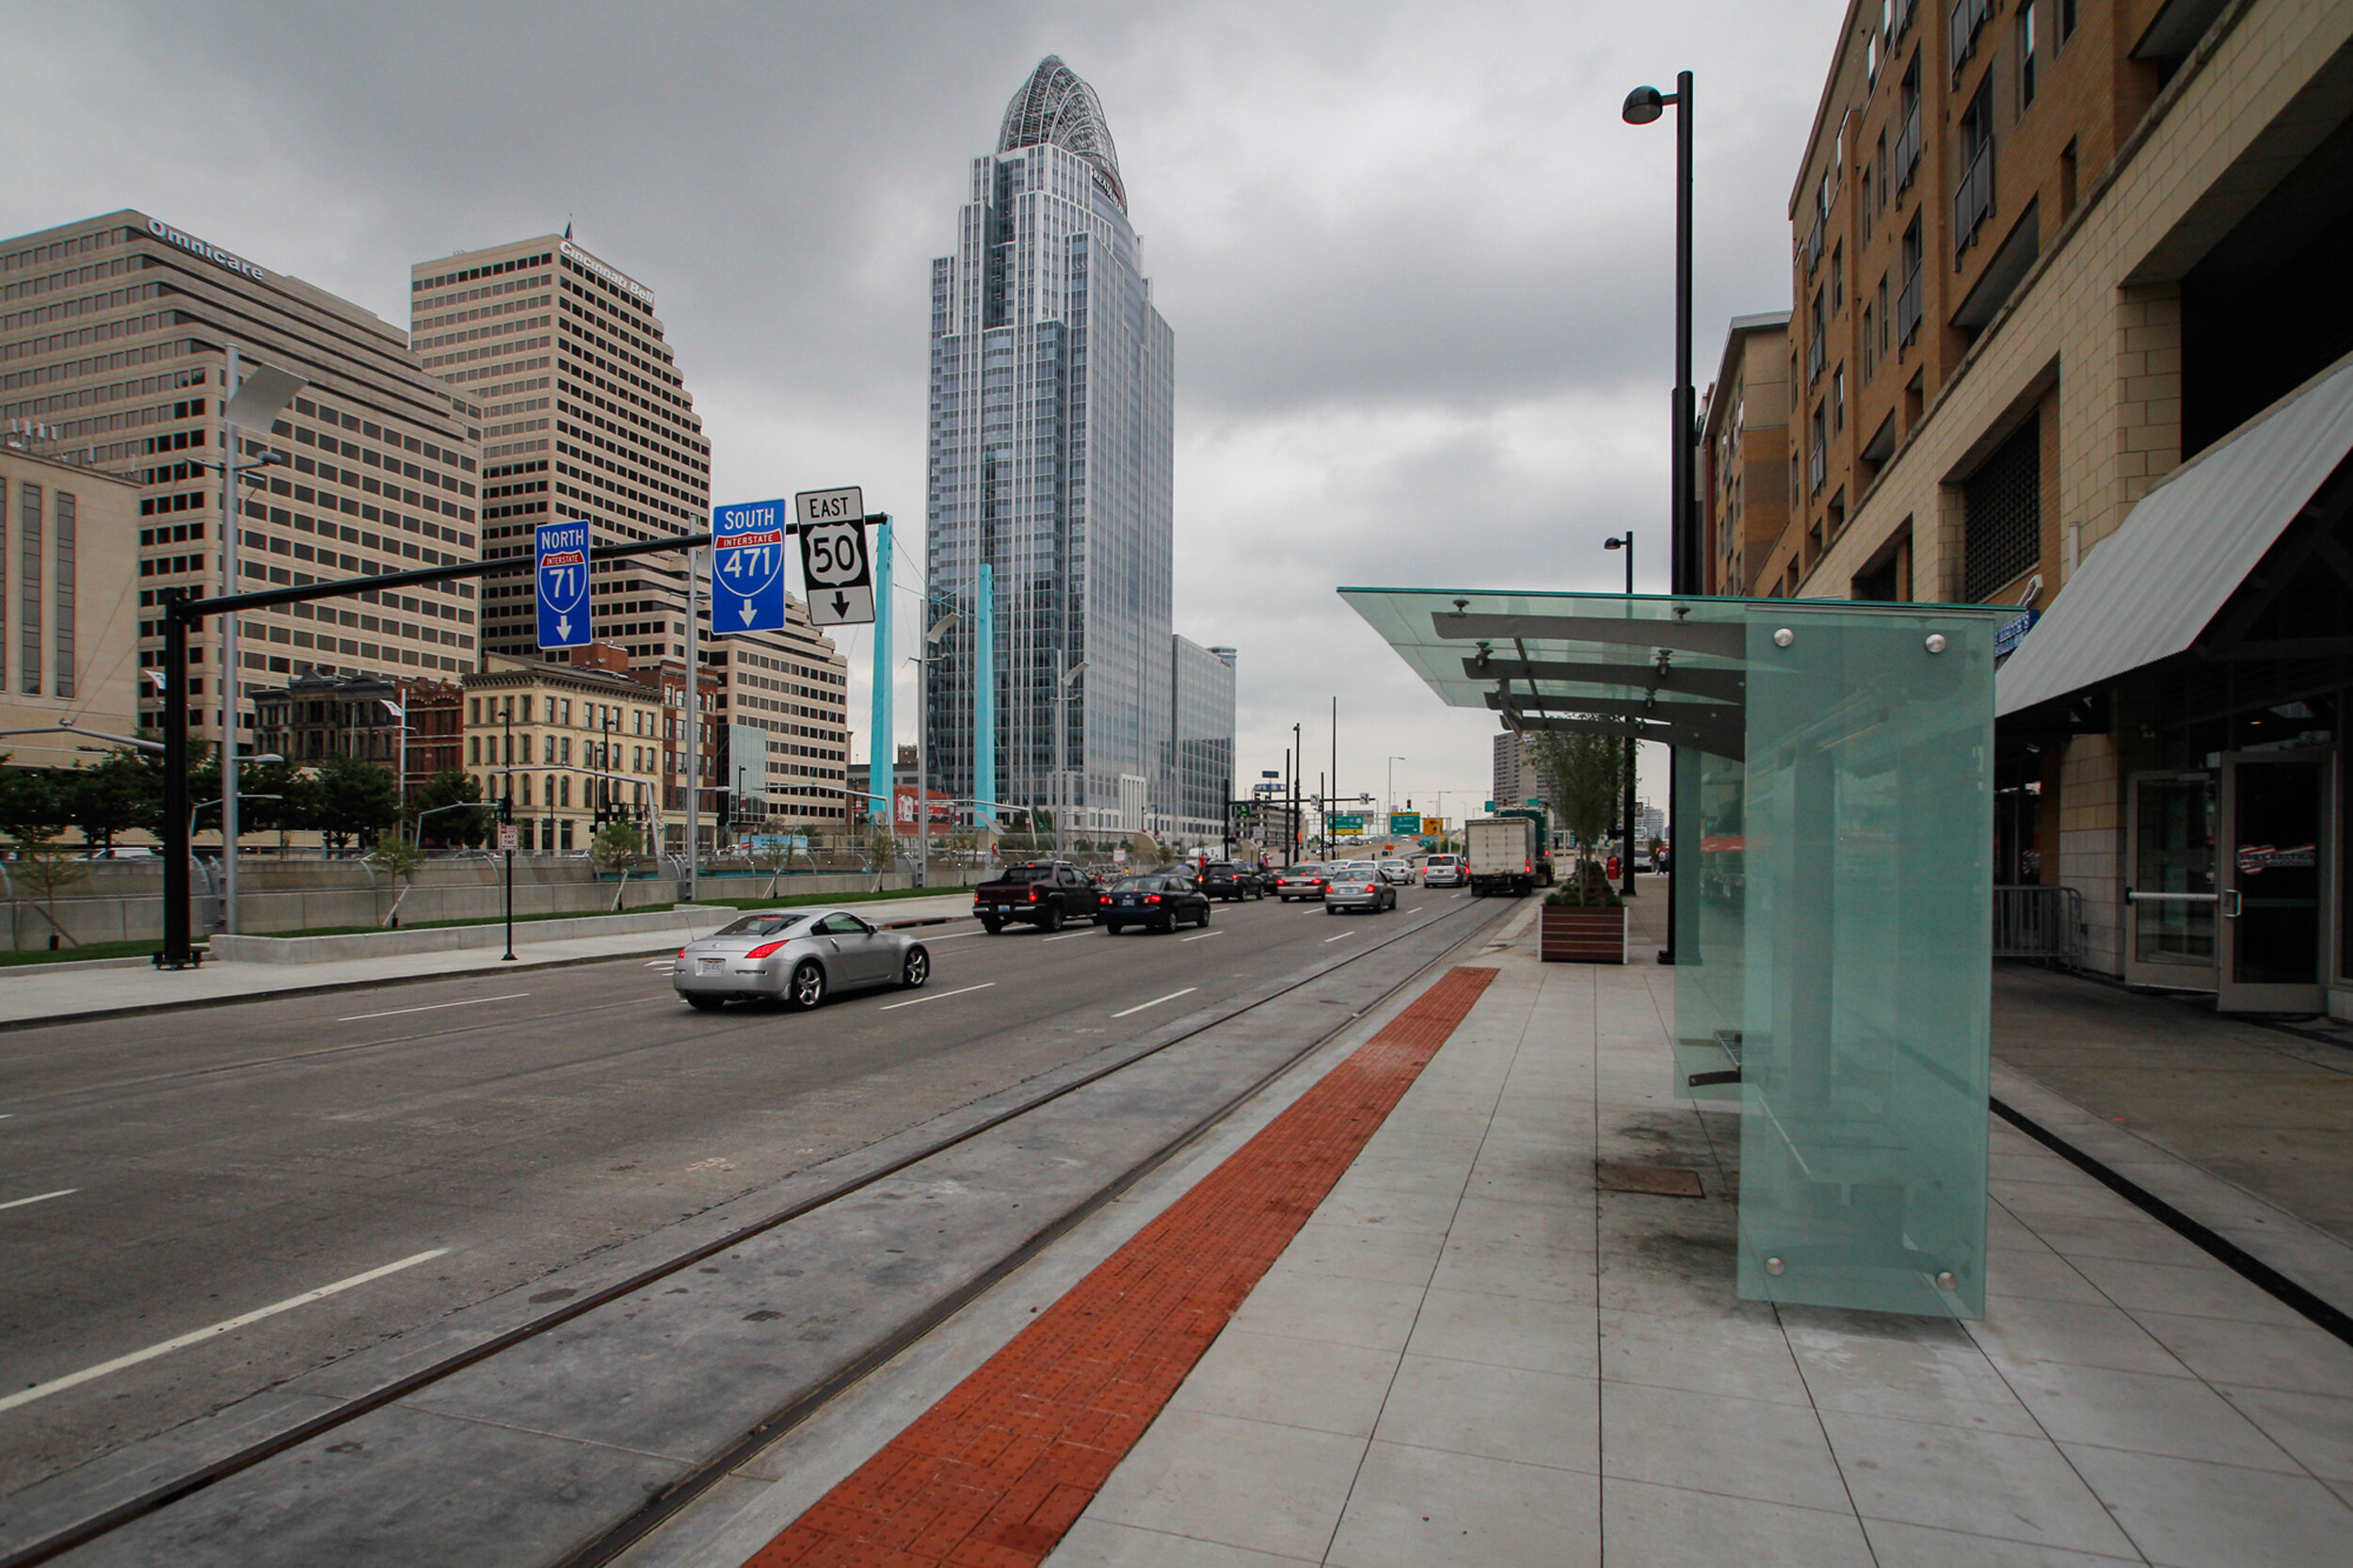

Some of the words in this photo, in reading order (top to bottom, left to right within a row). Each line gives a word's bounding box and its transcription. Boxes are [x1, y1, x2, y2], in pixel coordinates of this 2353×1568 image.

[147, 217, 264, 280] Omnicare
[560, 241, 628, 289] Cincinnati
[630, 280, 654, 304] Bell
[724, 507, 775, 531] SOUTH
[809, 497, 848, 519] EAST
[541, 528, 584, 551] NORTH
[723, 534, 774, 547] INTERSTATE
[546, 554, 579, 565] INTERSTATE
[723, 547, 770, 578] 471
[813, 535, 855, 573] 50
[549, 568, 575, 599] 71
